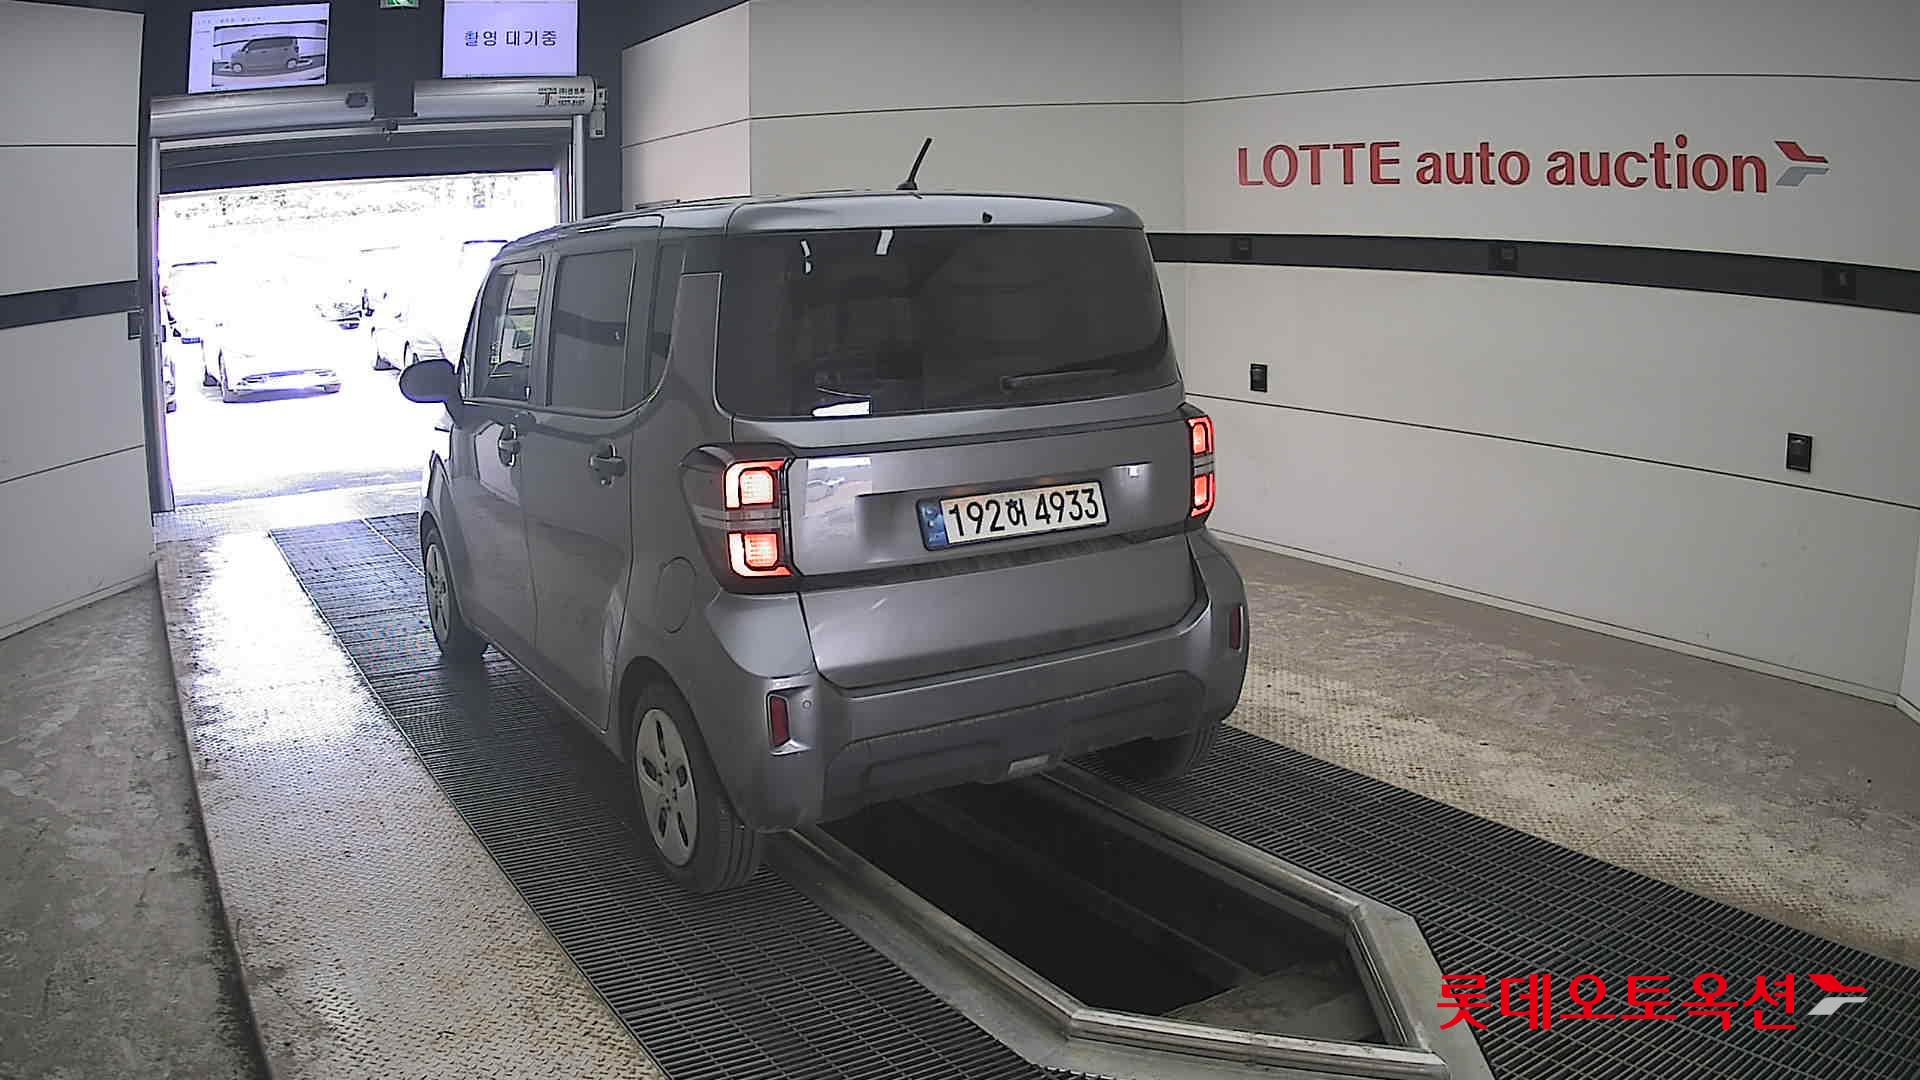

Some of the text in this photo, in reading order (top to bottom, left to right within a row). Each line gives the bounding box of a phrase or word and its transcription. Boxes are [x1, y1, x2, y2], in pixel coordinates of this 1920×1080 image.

[505, 29, 558, 46] 대기중
[1237, 134, 1768, 193] LOTTE auto auction
[949, 487, 1099, 537] 192허 4933
